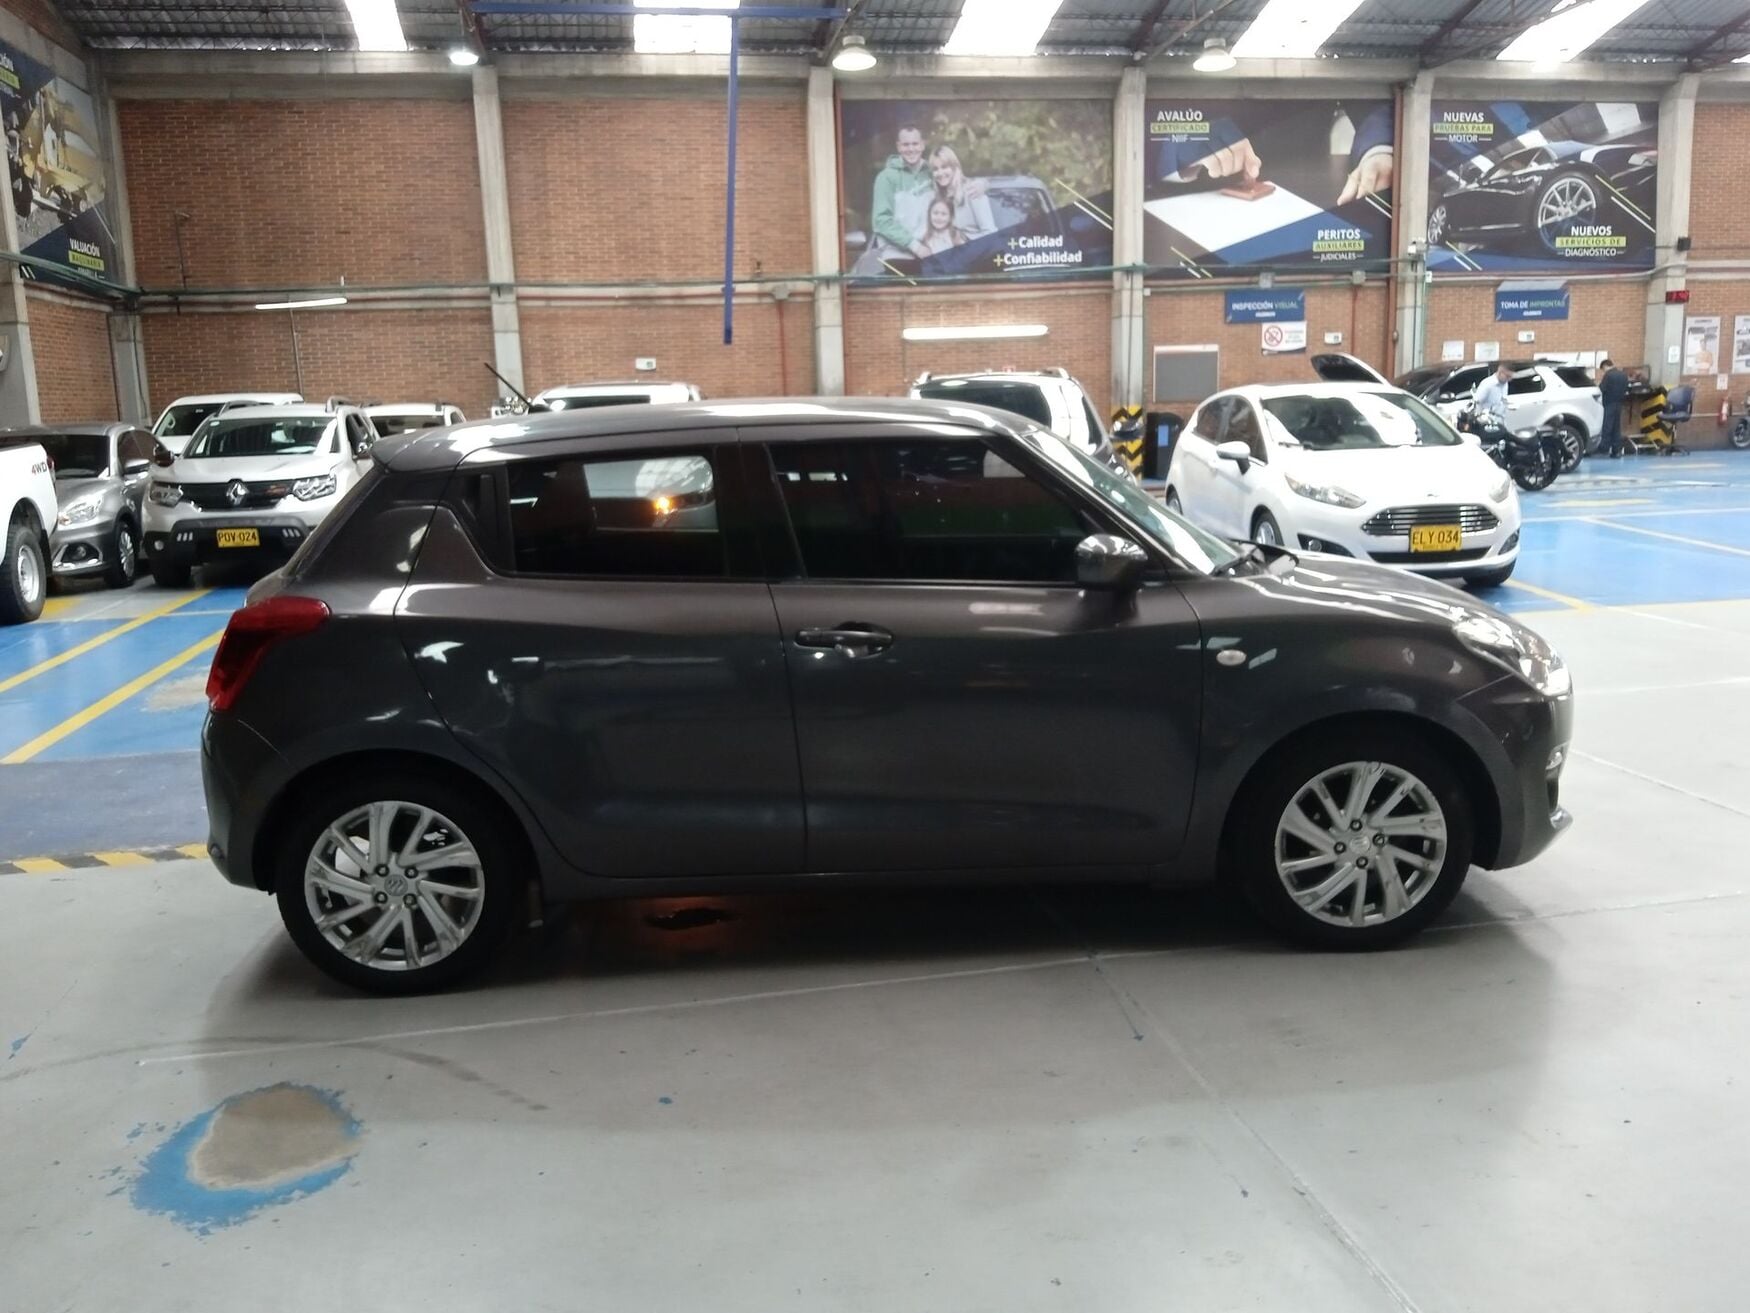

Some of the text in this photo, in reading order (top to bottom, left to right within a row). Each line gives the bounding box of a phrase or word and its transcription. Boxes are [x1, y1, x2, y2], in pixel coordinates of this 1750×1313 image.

[1157, 108, 1203, 121] AVALÚO
[1443, 111, 1485, 123] NUEVAS
[1151, 123, 1208, 132] CERTIFICADO
[1471, 124, 1492, 132] PARA
[1448, 134, 1478, 143] MOTOR
[1317, 228, 1361, 240] PERITOS
[1571, 225, 1612, 236] NUEVOS
[1564, 247, 1617, 257] DIAGNÓSTICO
[1500, 300, 1519, 310] TOMA
[1519, 300, 1529, 309] DE
[31, 461, 48, 475] 4WD
[1437, 530, 1459, 544] 034
